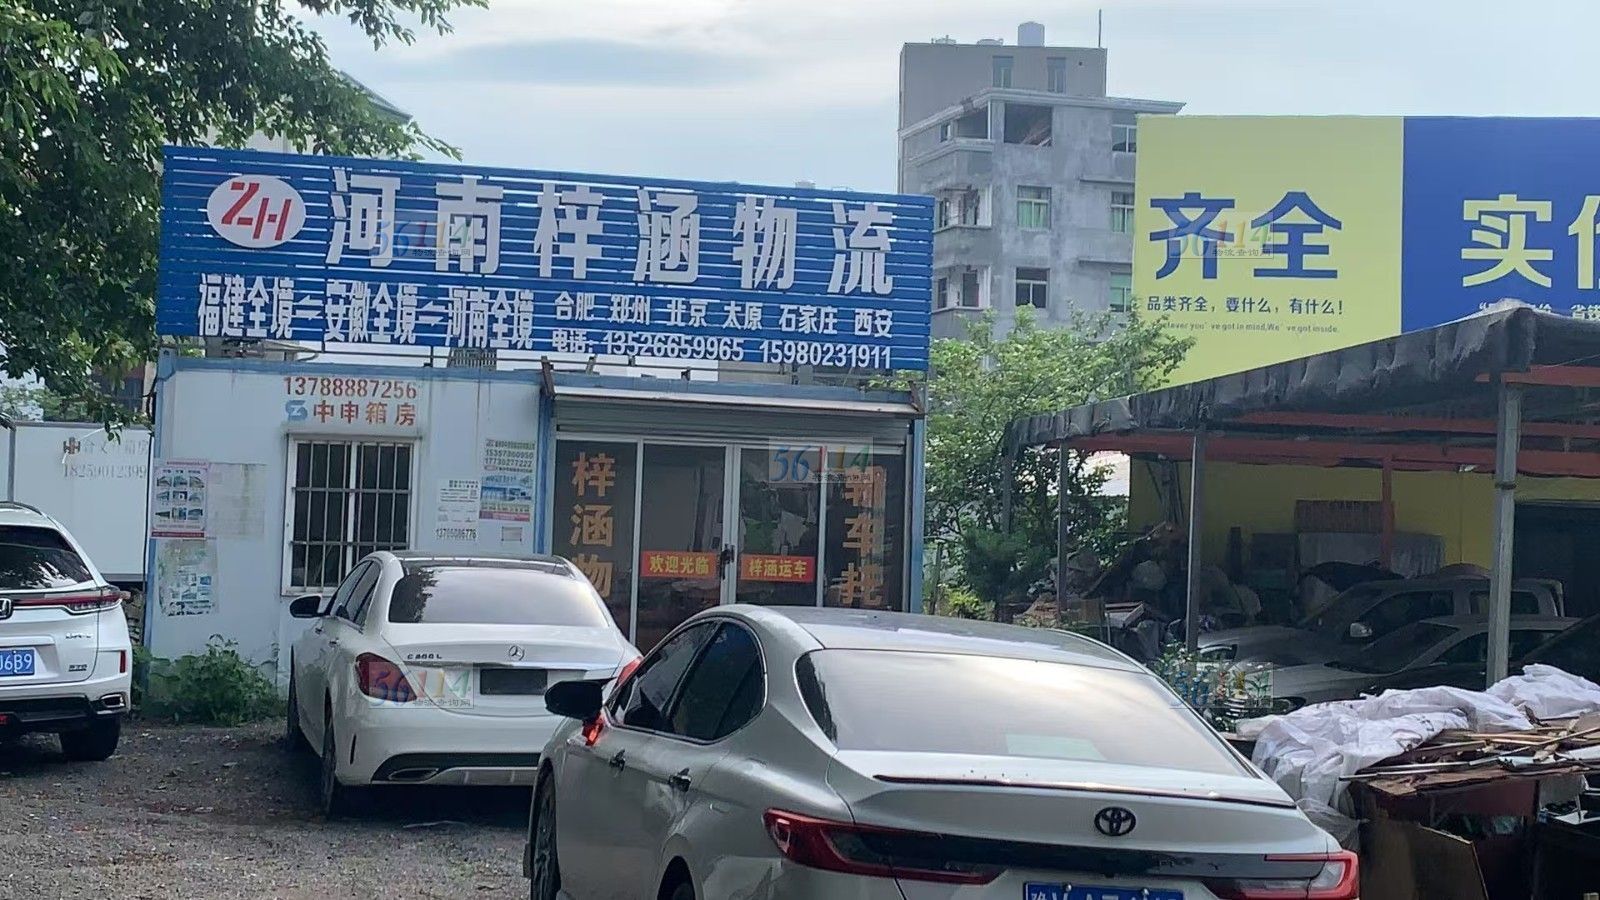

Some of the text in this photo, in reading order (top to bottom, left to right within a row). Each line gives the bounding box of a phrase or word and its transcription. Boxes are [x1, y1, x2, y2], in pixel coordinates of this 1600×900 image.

[220, 181, 293, 241] ZH
[326, 168, 895, 296] 河南梓涵物流
[1149, 191, 1343, 280] 齐全
[555, 291, 893, 338] 合肥 郑州 北京 太原 石家庄 西安
[603, 331, 745, 361] 13526659965
[760, 340, 891, 369] 15980231911
[284, 377, 417, 399] 13788887256
[313, 400, 417, 426] 中申箱房
[650, 553, 710, 574] 欢迎光临
